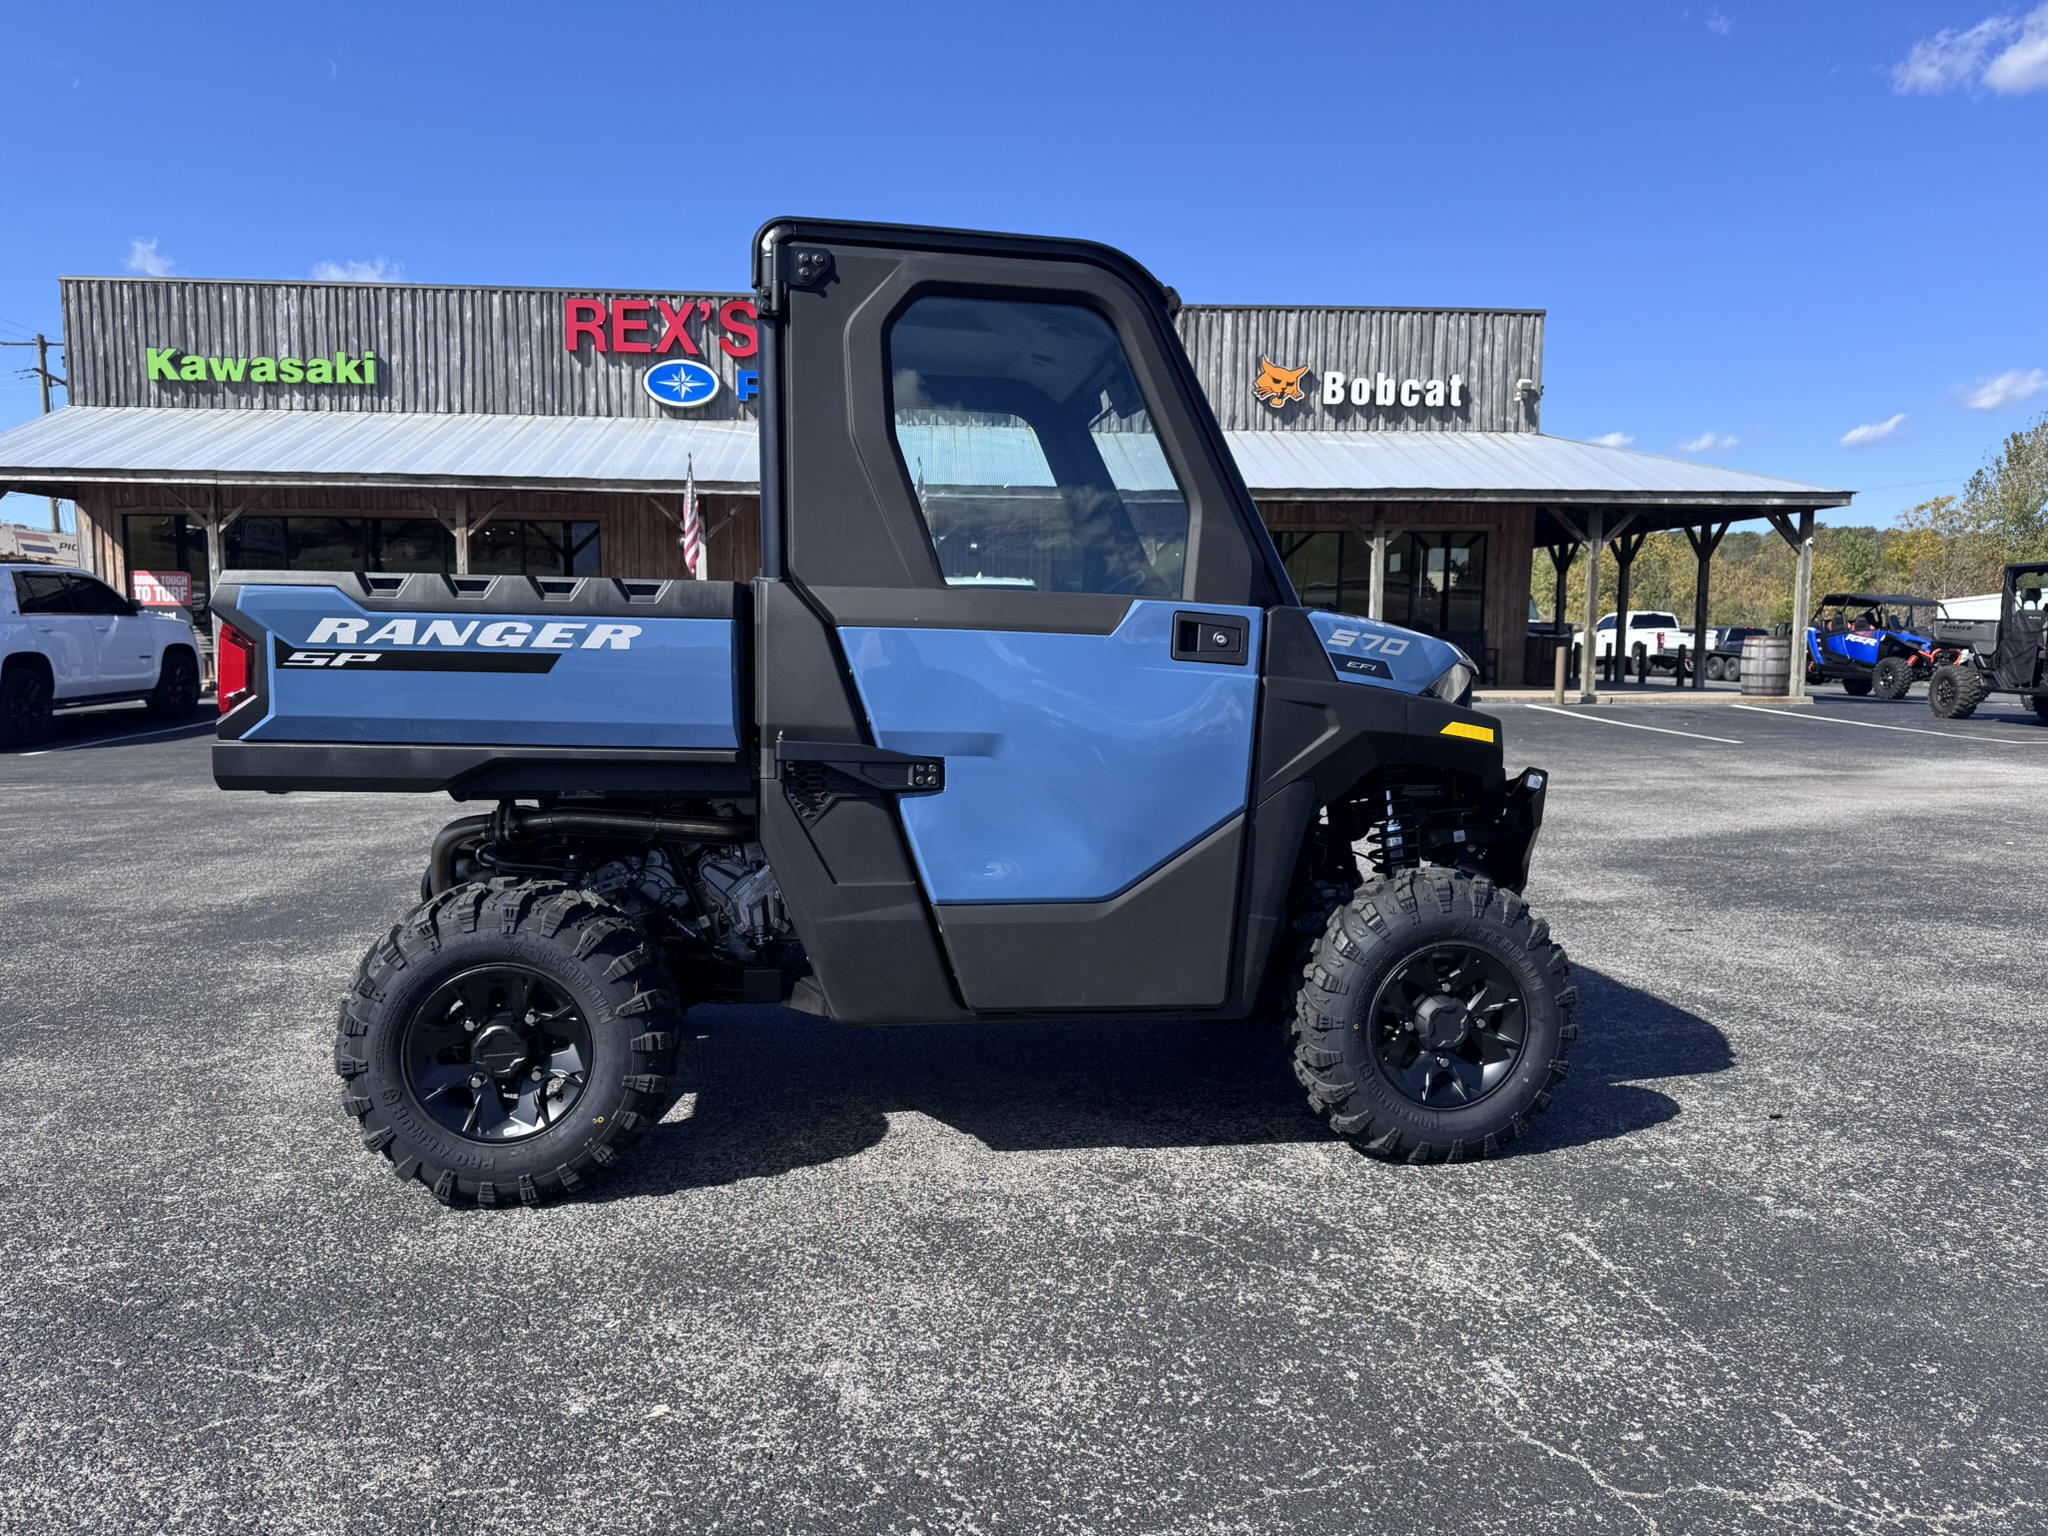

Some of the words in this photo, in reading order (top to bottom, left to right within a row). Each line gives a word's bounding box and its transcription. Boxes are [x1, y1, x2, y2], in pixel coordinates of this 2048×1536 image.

[565, 298, 759, 357] REX'S
[146, 347, 376, 385] Kawasaki
[1323, 371, 1462, 407] Bobcat
[133, 575, 159, 586] BRING
[160, 575, 188, 586] TOUGH
[134, 586, 152, 602] TO
[153, 586, 188, 602] TURF
[306, 617, 643, 649] RANGER
[1327, 629, 1410, 655] 570
[1845, 633, 1877, 646] RZR
[283, 652, 382, 667] SP
[1346, 660, 1377, 671] EFI
[453, 1151, 496, 1171] PRO
